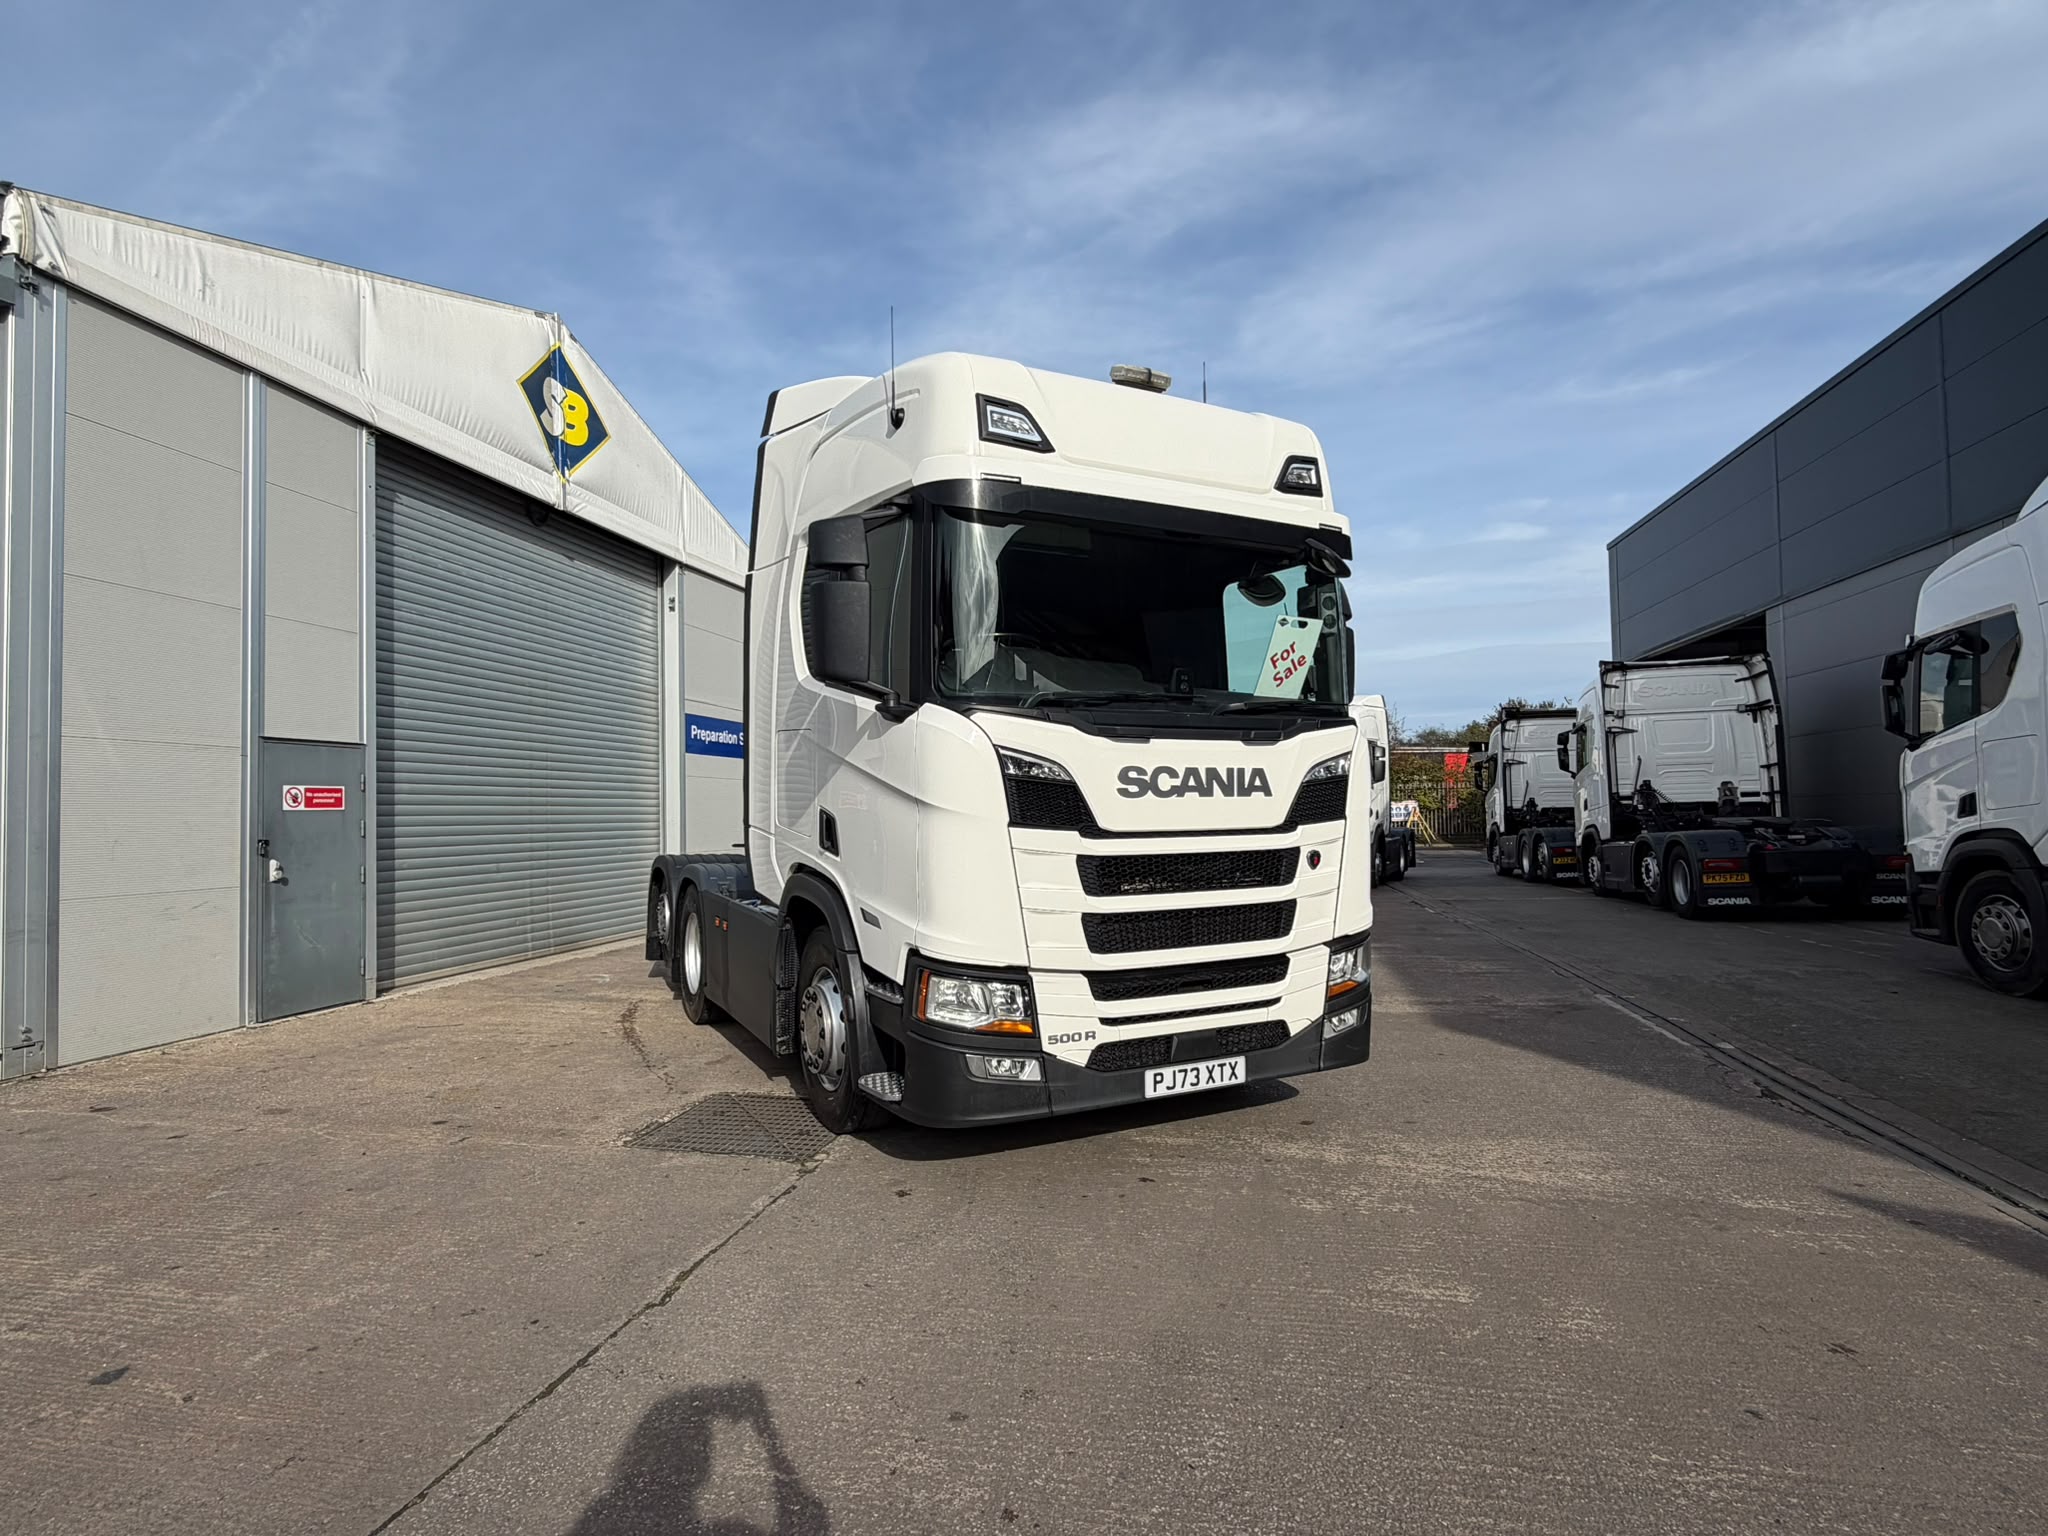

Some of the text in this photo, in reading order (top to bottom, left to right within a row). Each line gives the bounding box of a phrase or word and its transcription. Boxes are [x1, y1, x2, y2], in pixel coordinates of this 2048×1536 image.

[1270, 641, 1296, 670] For
[1273, 655, 1307, 688] Sale
[691, 724, 738, 745] Preparation
[1116, 765, 1273, 799] SCANIA
[1707, 896, 1752, 905] SCANIA
[1047, 1030, 1097, 1045] 500 R
[1153, 1061, 1239, 1093] PJ73 XTX
